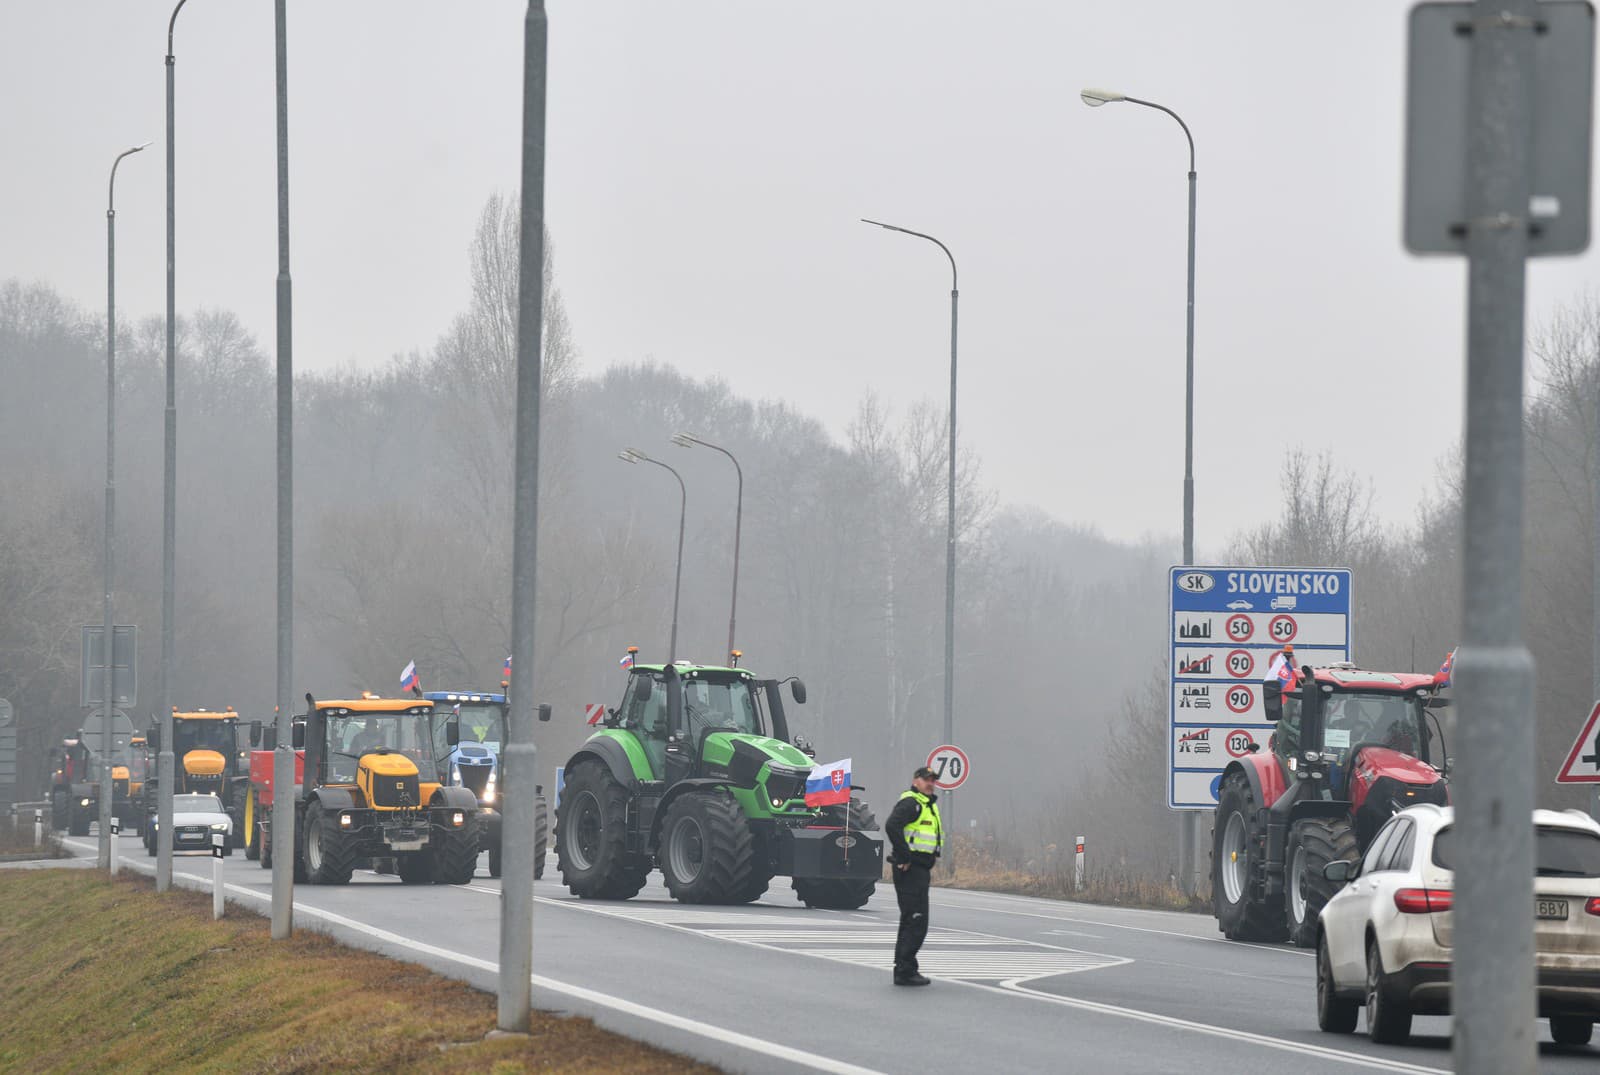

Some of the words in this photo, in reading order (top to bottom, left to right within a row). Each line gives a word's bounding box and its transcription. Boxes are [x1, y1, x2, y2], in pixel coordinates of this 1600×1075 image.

[1187, 575, 1204, 589] SK
[1227, 572, 1340, 595] SLOVENSKO
[1231, 621, 1250, 635] 50
[1274, 622, 1293, 636] 50
[1231, 657, 1249, 670] 90
[1230, 692, 1249, 706] 90
[1231, 737, 1249, 751] 130
[936, 756, 962, 779] 70
